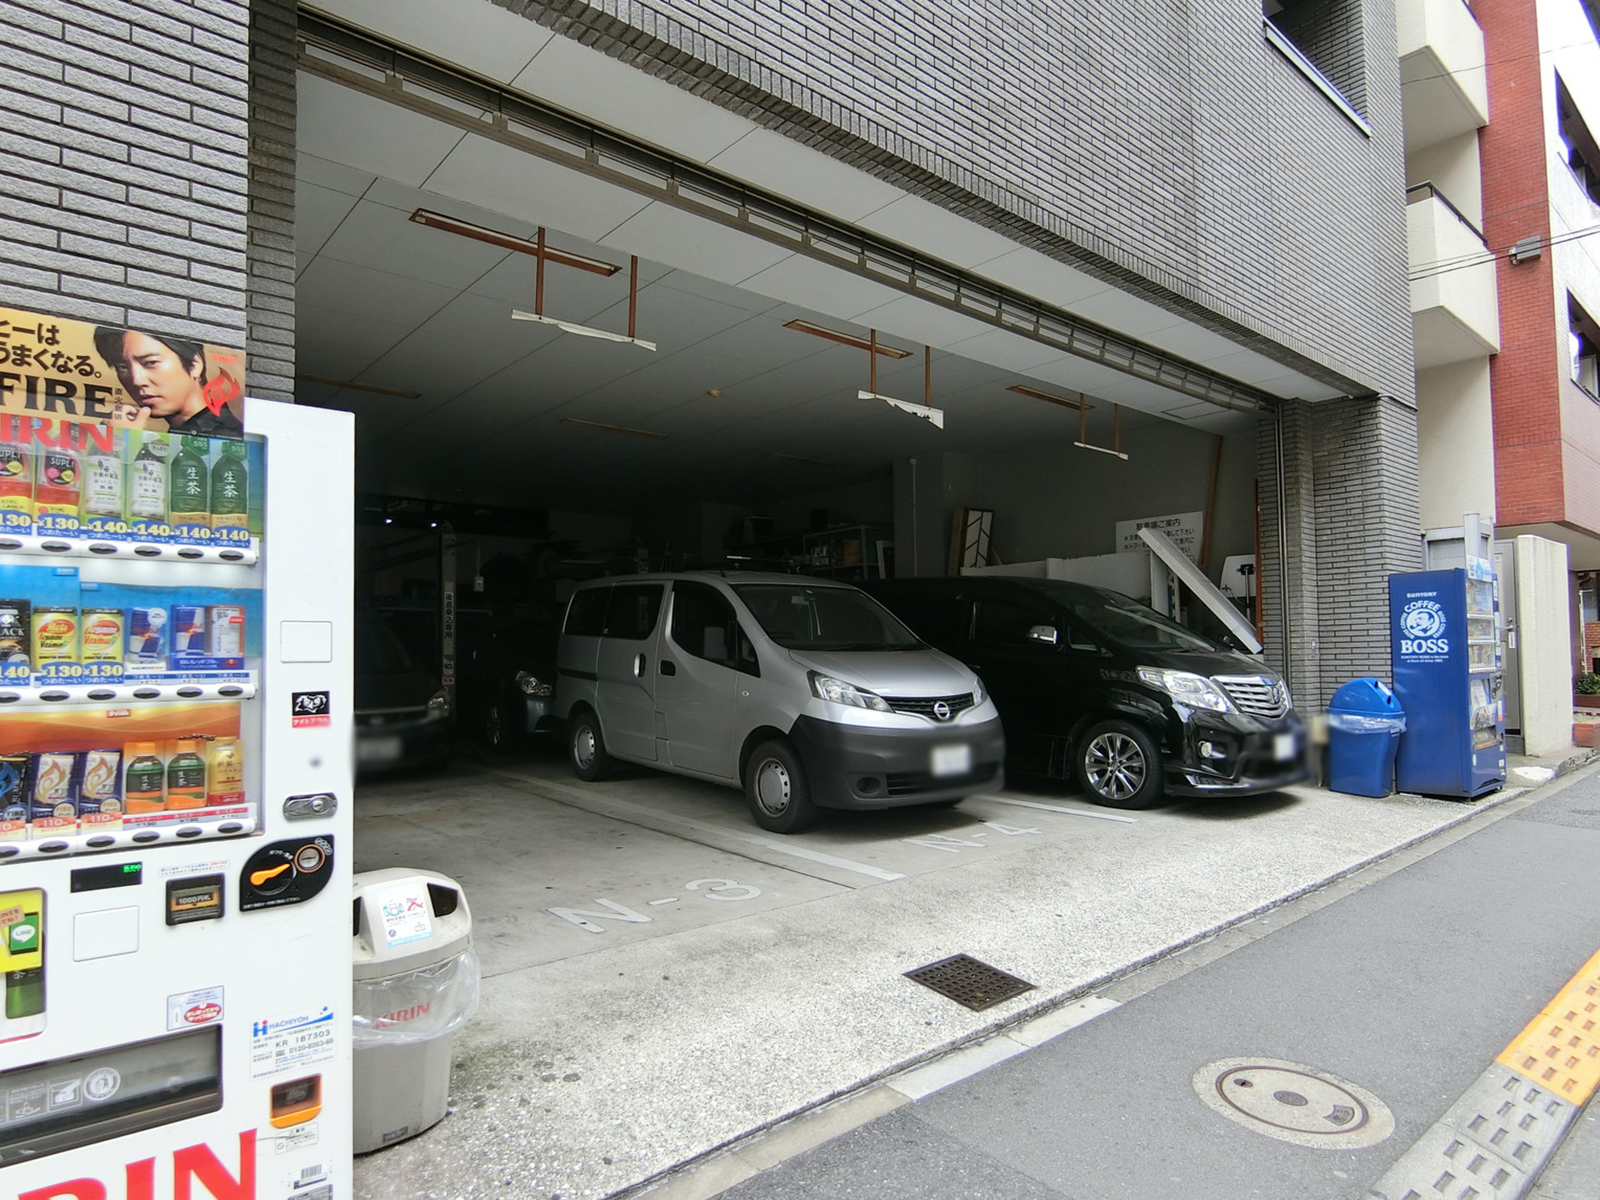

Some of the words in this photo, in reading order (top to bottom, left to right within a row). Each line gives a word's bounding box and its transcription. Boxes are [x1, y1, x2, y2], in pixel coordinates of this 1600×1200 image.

[0, 371, 113, 419] FIRE
[186, 467, 201, 495] 生茶
[223, 470, 238, 498] 生茶
[1404, 600, 1441, 613] COFFEE
[1401, 638, 1449, 653] BOSS
[903, 822, 1042, 853] N-4
[545, 878, 762, 933] N-3
[15, 929, 32, 937] LINE
[269, 1015, 309, 1029] HACHIYOH
[374, 1001, 431, 1029] KIRIN
[275, 1039, 288, 1049] KR
[295, 1029, 331, 1044] 187303
